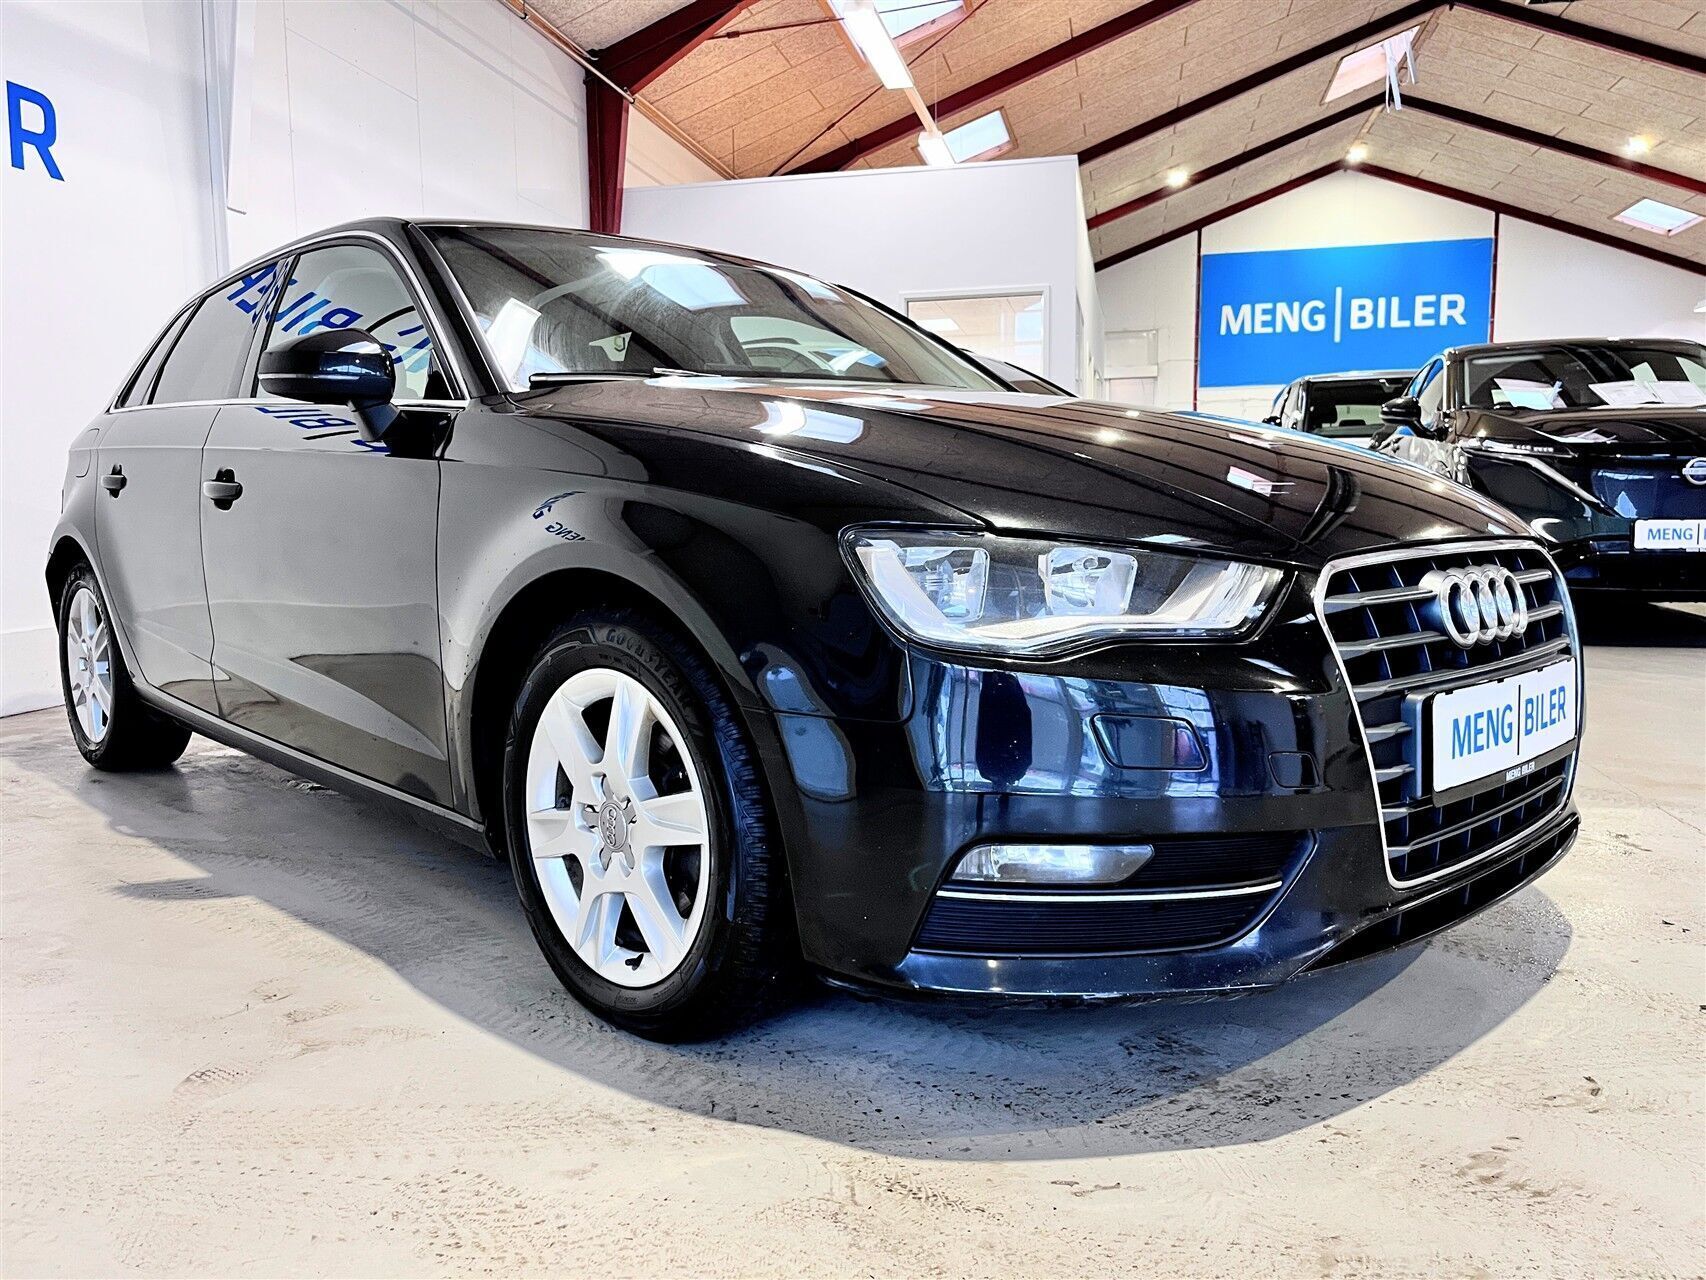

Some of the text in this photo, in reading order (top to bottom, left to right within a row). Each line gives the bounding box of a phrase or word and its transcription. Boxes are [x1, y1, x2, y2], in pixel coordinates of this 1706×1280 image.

[1220, 294, 1466, 335] MENG BILER
[1647, 527, 1693, 541] MENG
[1452, 685, 1566, 760] MENG BILER
[1506, 761, 1535, 781] MENG BILER
